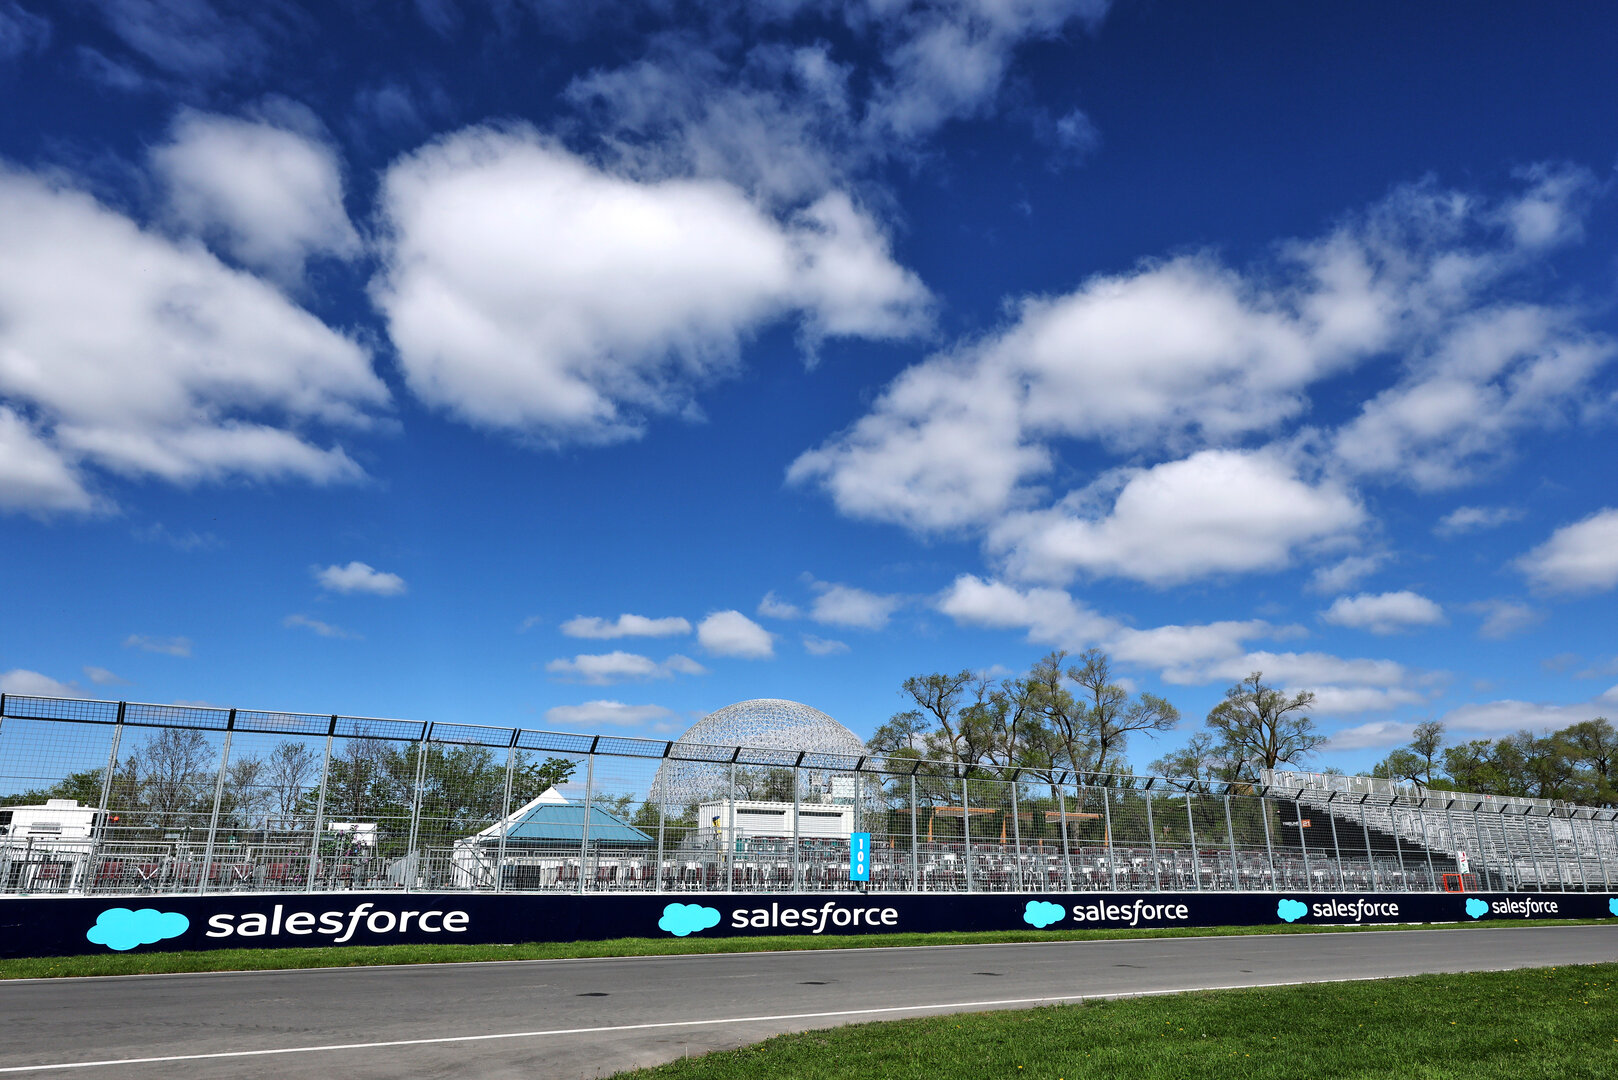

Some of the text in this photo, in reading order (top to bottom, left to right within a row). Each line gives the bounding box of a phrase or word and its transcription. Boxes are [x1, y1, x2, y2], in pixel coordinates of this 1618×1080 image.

[731, 902, 899, 934] salesforce
[1072, 900, 1189, 926] salesforce
[1312, 899, 1399, 922] salesforce
[1491, 897, 1559, 917] salesforce
[206, 903, 470, 942] salesforce
